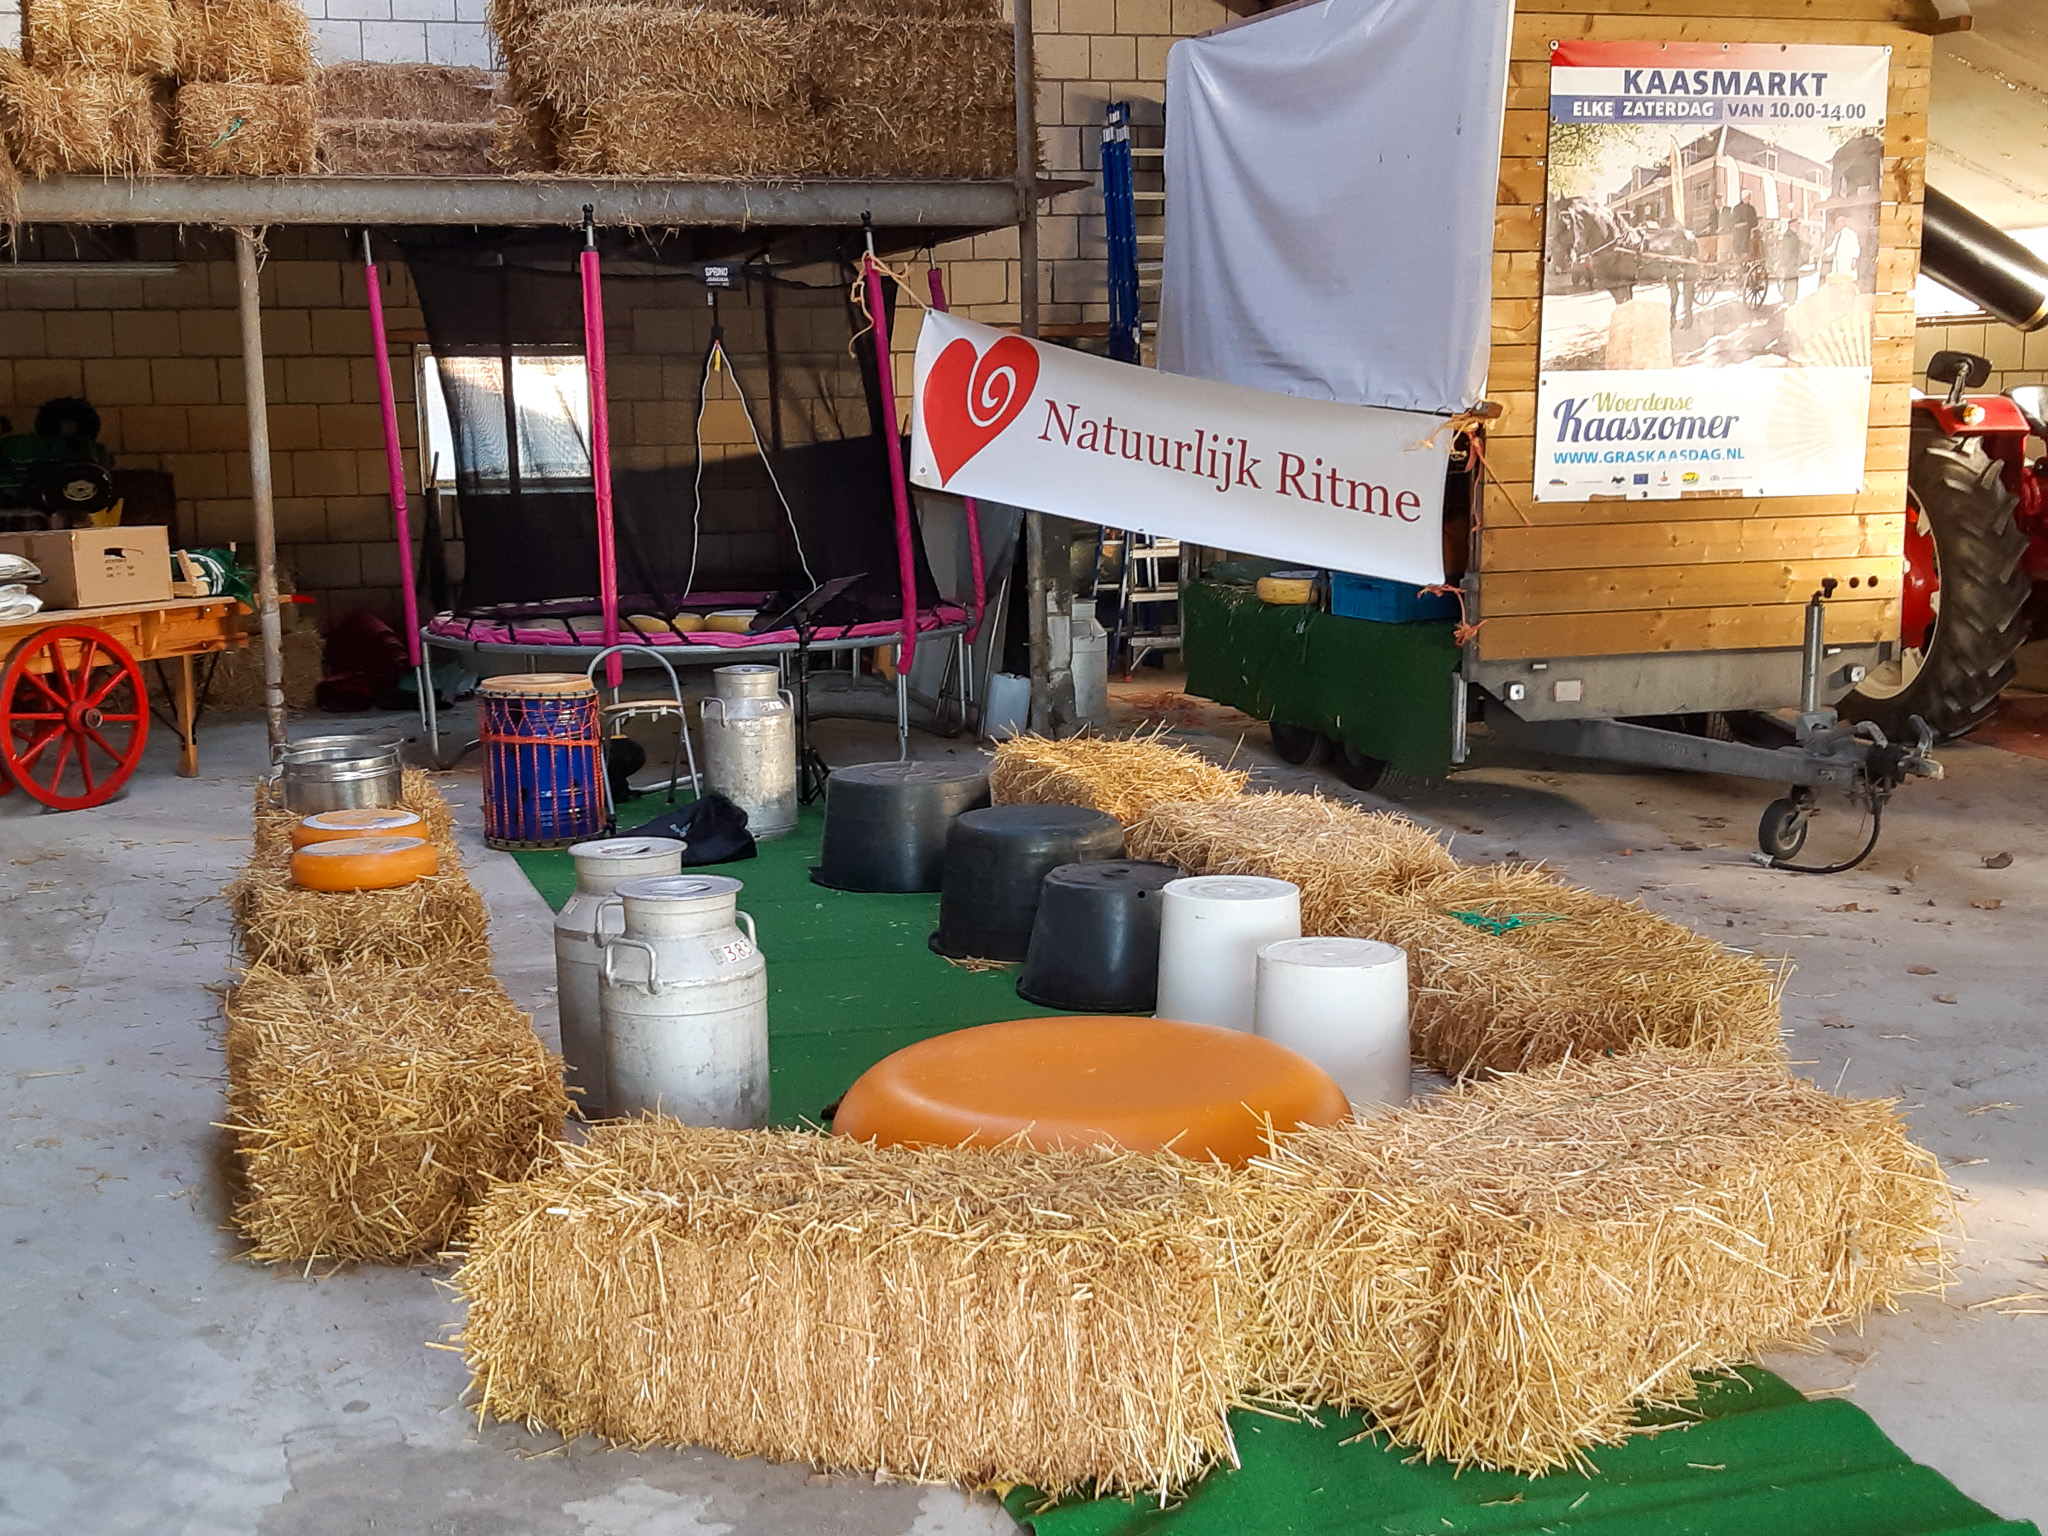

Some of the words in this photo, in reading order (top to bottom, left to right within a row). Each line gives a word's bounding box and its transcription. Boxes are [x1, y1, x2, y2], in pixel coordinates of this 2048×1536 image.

[1623, 69, 1828, 96] KAASMARKT
[1572, 101, 1614, 117] ELKE
[1622, 100, 1714, 117] ZATERDAG
[1727, 102, 1765, 118] VAN
[1769, 102, 1867, 121] 10.00-14.00
[1592, 392, 1694, 412] Woerdense
[1553, 398, 1740, 443] Kaaszomer
[1038, 398, 1263, 493] Natuurlijk
[1276, 451, 1422, 523] Ritme
[1553, 448, 1745, 464] WWW.GRASKAASDAG.NL
